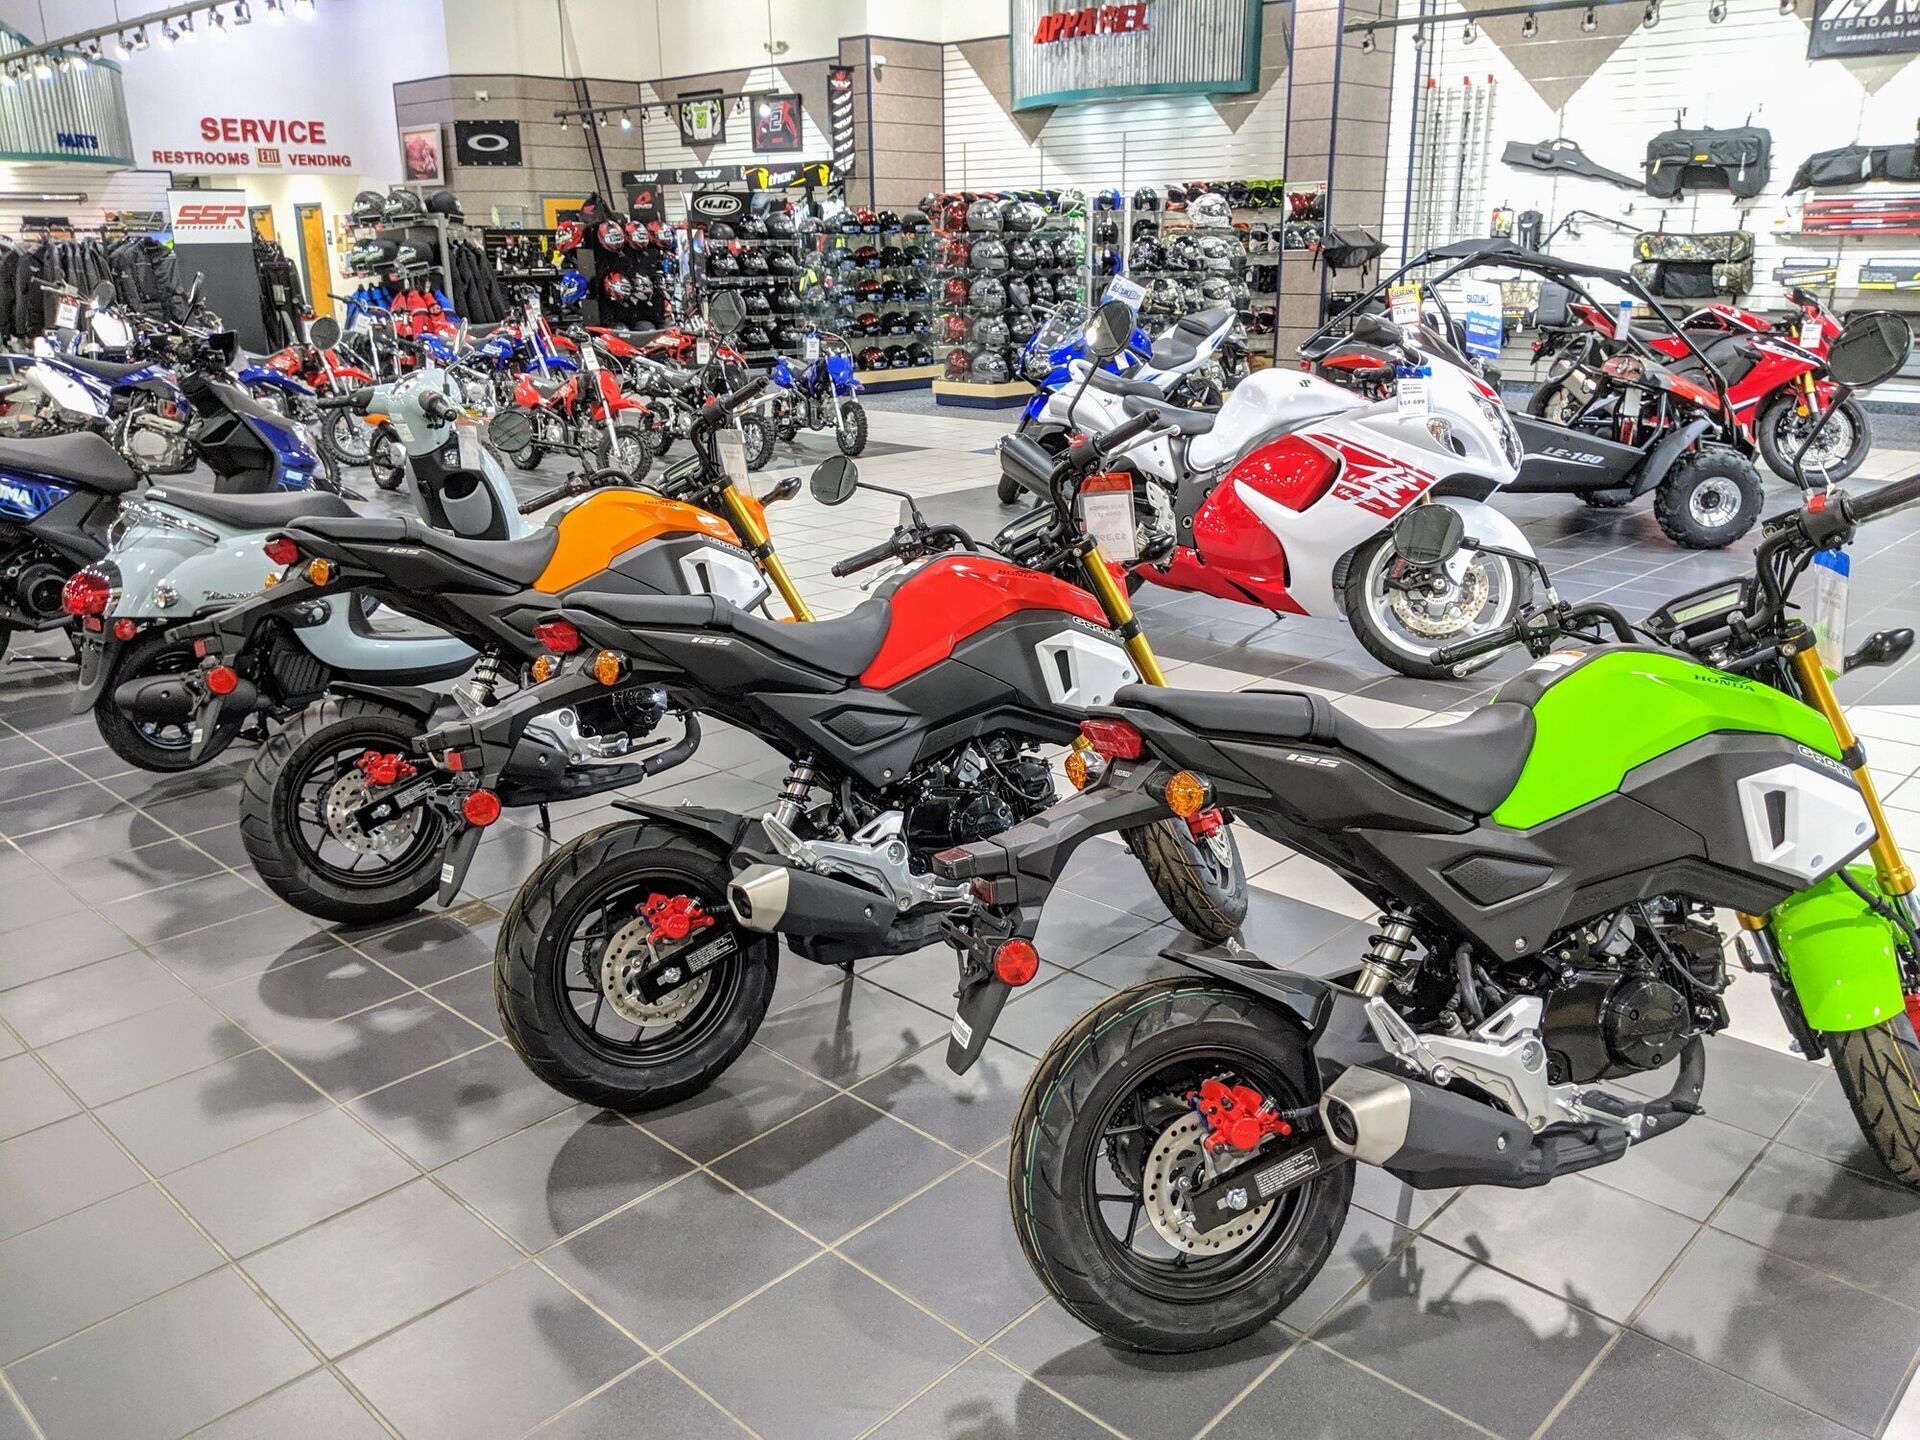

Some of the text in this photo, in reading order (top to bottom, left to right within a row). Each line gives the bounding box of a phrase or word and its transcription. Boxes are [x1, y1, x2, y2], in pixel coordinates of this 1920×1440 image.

[1033, 3, 1150, 44] APPAREL
[200, 117, 327, 145] SERVICE
[56, 131, 99, 150] PARTS
[152, 150, 250, 166] RESTROOMS
[260, 150, 280, 163] EXIT
[288, 153, 352, 167] VENDING
[769, 170, 796, 186] thor
[702, 200, 734, 209] HJC
[176, 205, 247, 229] SSR
[1466, 293, 1489, 304] SUZUKI
[387, 547, 421, 555] 125
[998, 568, 1040, 580] HONDA
[1071, 615, 1116, 641] GROM
[691, 636, 732, 646] 125
[1694, 674, 1756, 692] HONDA
[1286, 753, 1341, 768] 125
[1797, 744, 1850, 779] GROM
